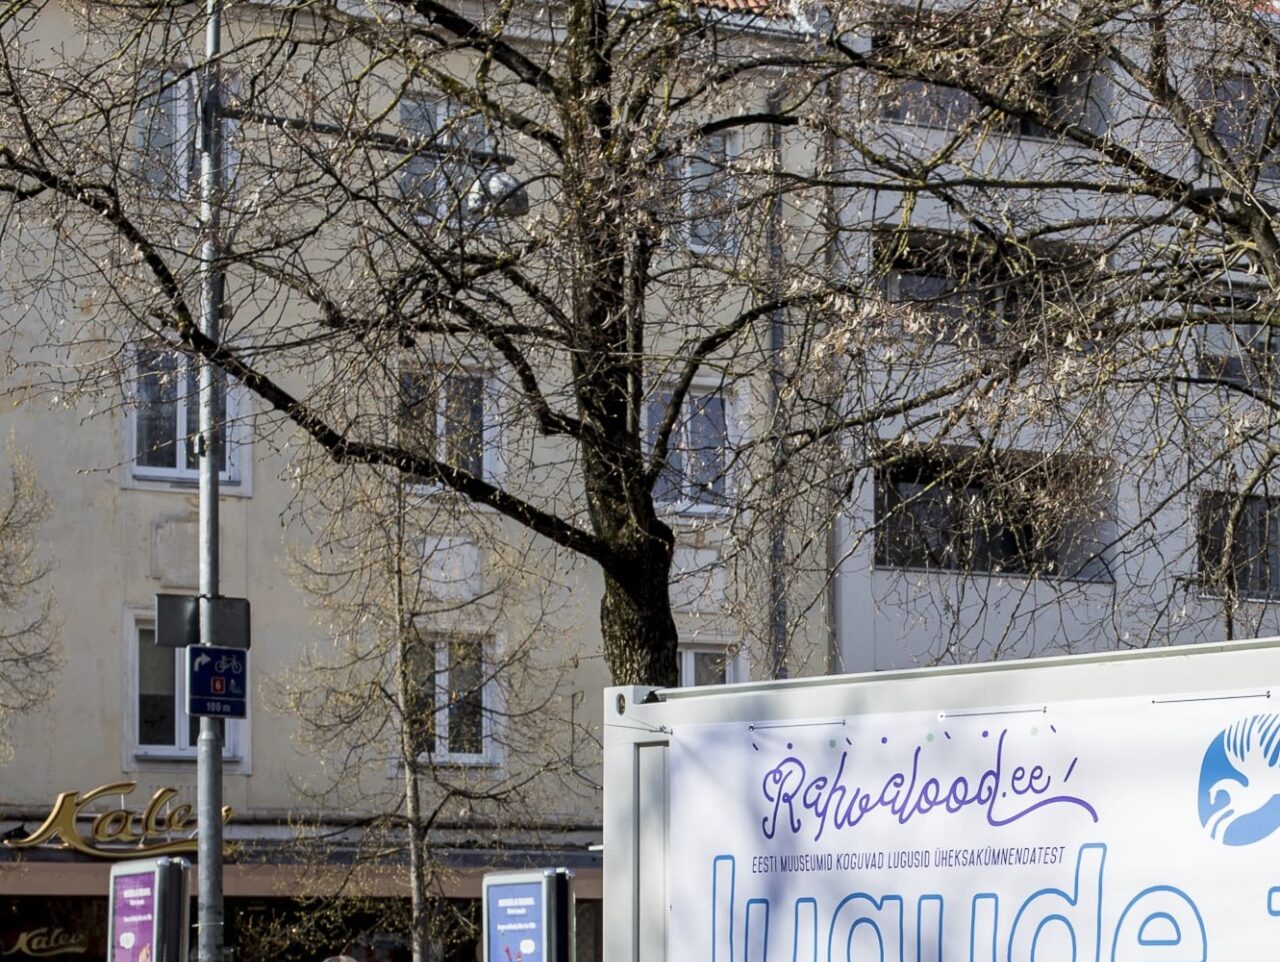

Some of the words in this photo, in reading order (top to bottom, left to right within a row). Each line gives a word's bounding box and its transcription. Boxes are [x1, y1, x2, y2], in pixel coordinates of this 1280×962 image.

[3, 780, 235, 857] Kale
[752, 856, 778, 873] EESTI
[780, 853, 833, 872] MUUSEUMID
[835, 852, 884, 871] KOGUVAD
[887, 850, 930, 868] LUGUSID
[934, 846, 1066, 867] ÜHEKSAKÜMNENDATEST
